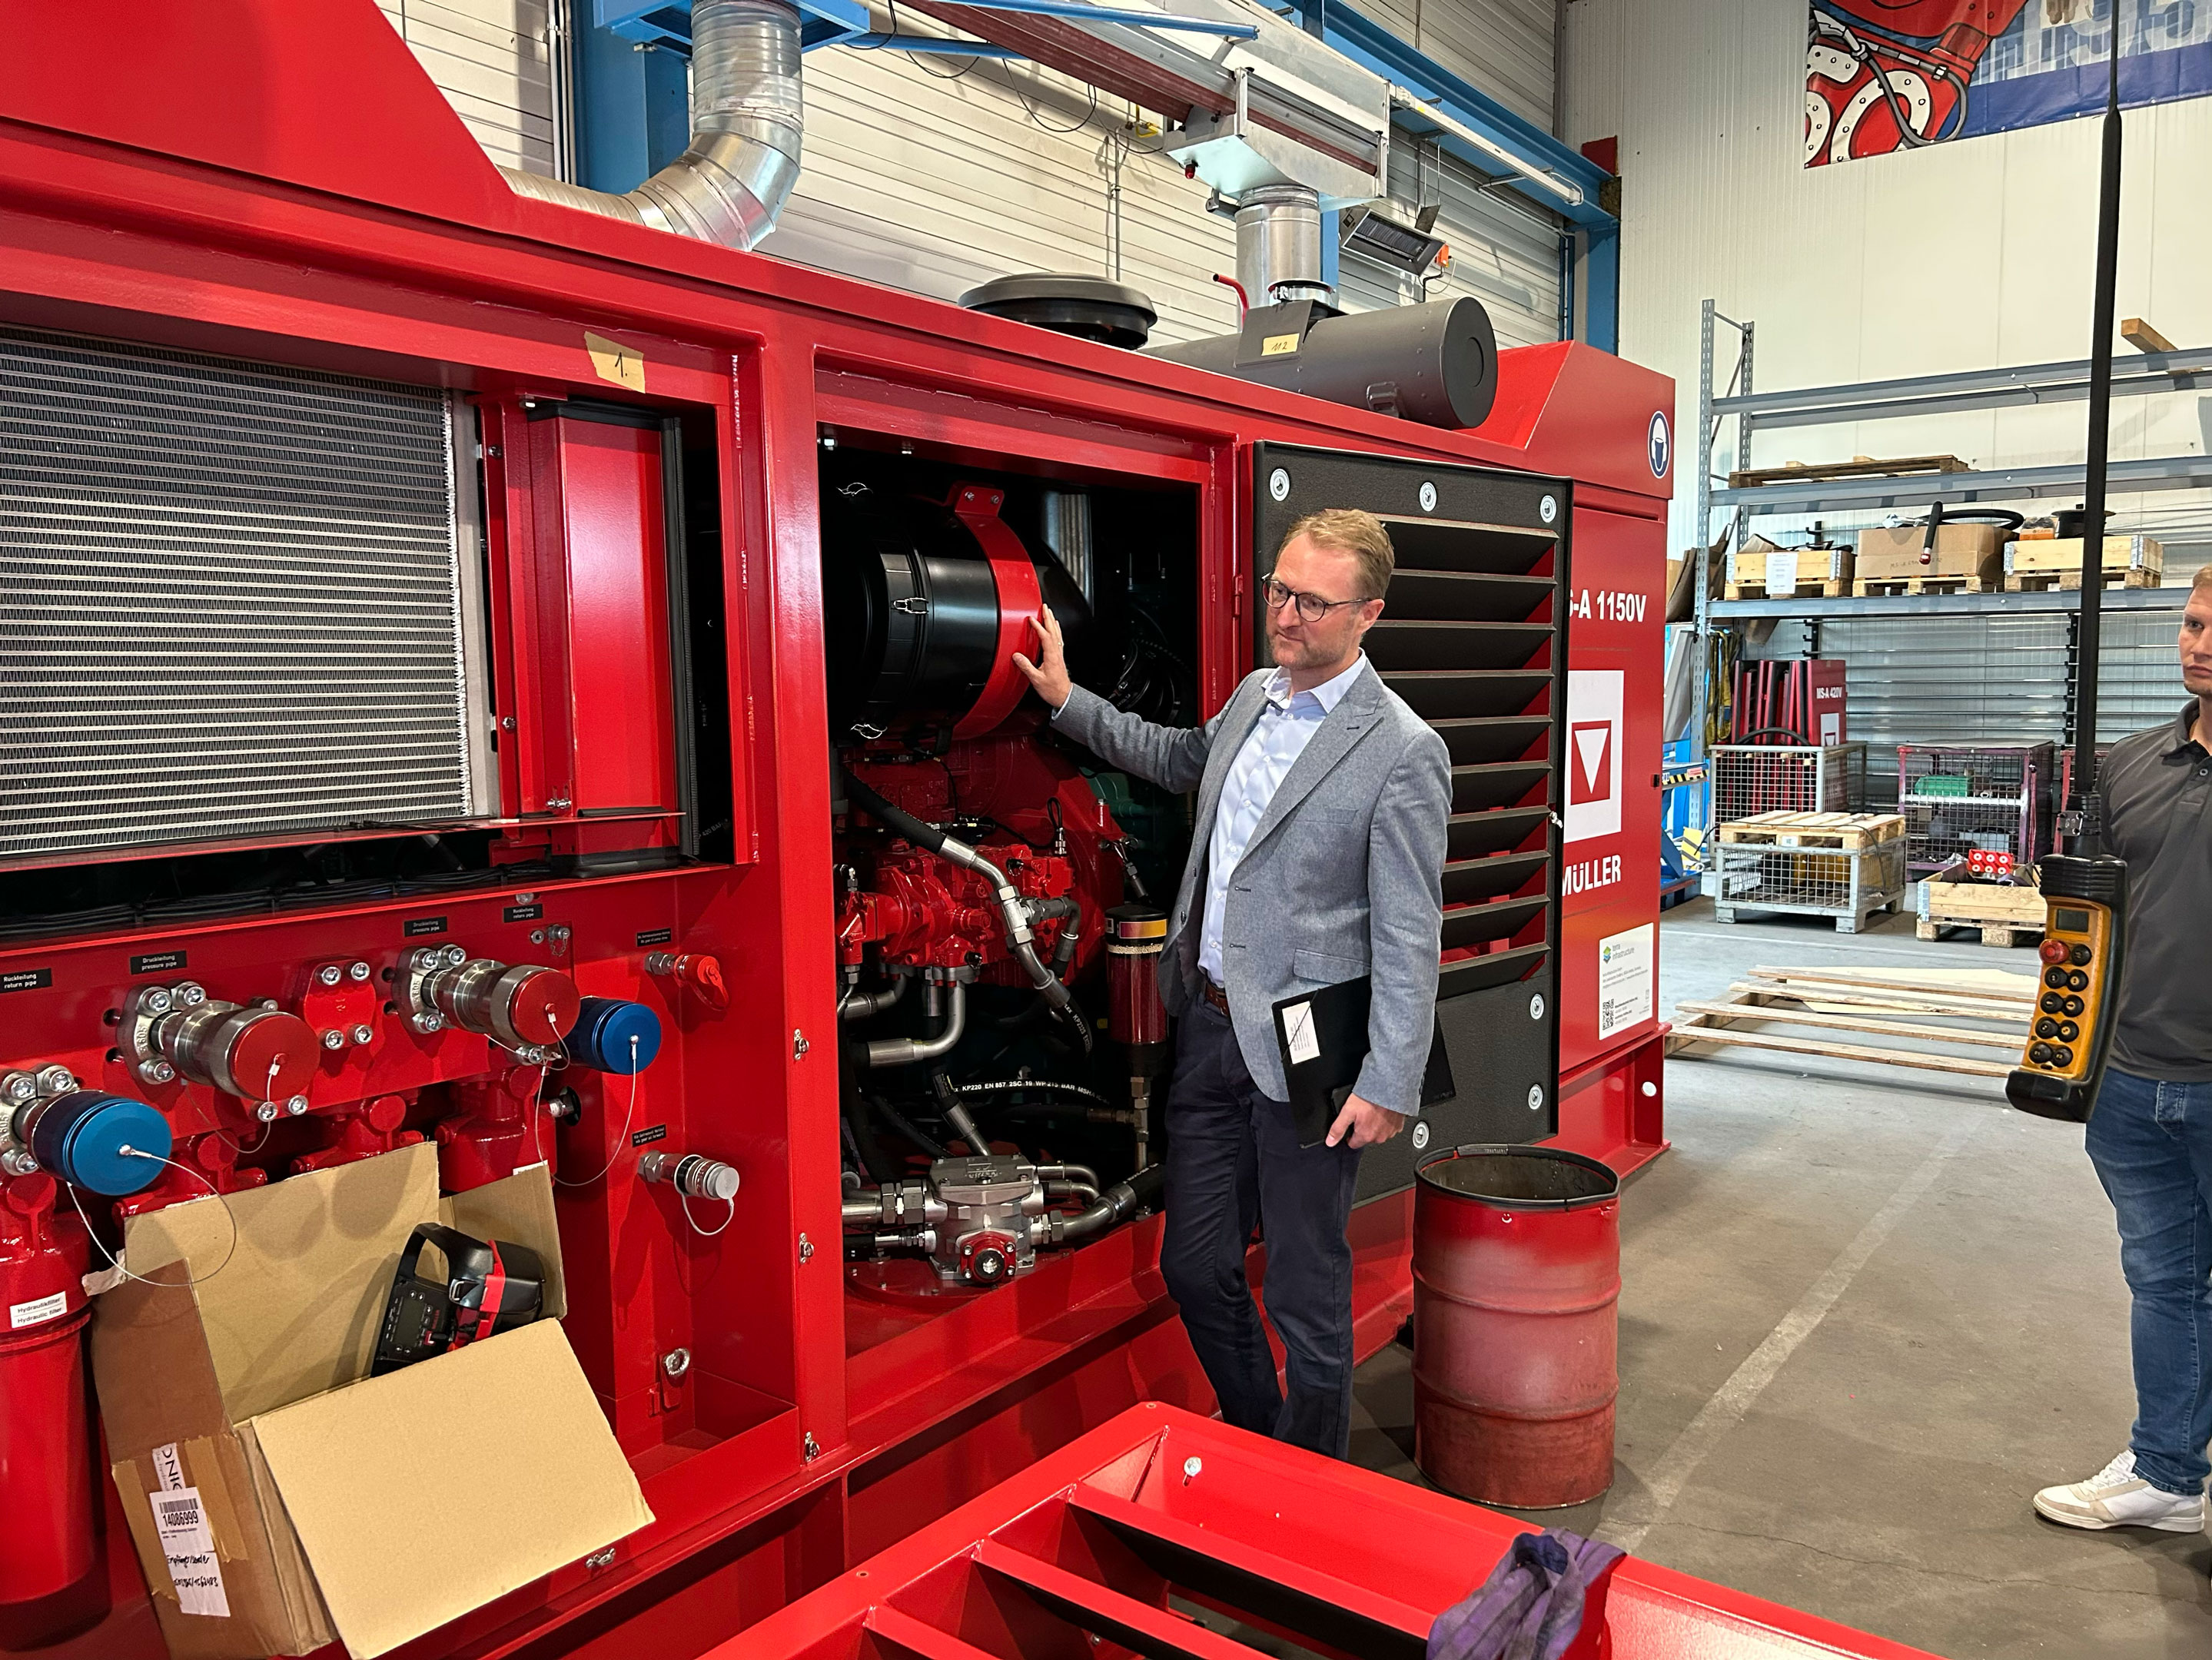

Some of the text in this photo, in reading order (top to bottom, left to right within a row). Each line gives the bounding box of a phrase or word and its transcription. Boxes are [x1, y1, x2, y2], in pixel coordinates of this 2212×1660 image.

[1596, 590, 1647, 622] 1150V
[1562, 854, 1621, 897] MÜLLER
[142, 954, 175, 964] Druckleitung
[3, 972, 37, 983] Rückleitung
[18, 1297, 61, 1313] Hydraulikfilter
[18, 1312, 48, 1323] Hydraulic
[163, 1510, 199, 1528] 14086999
